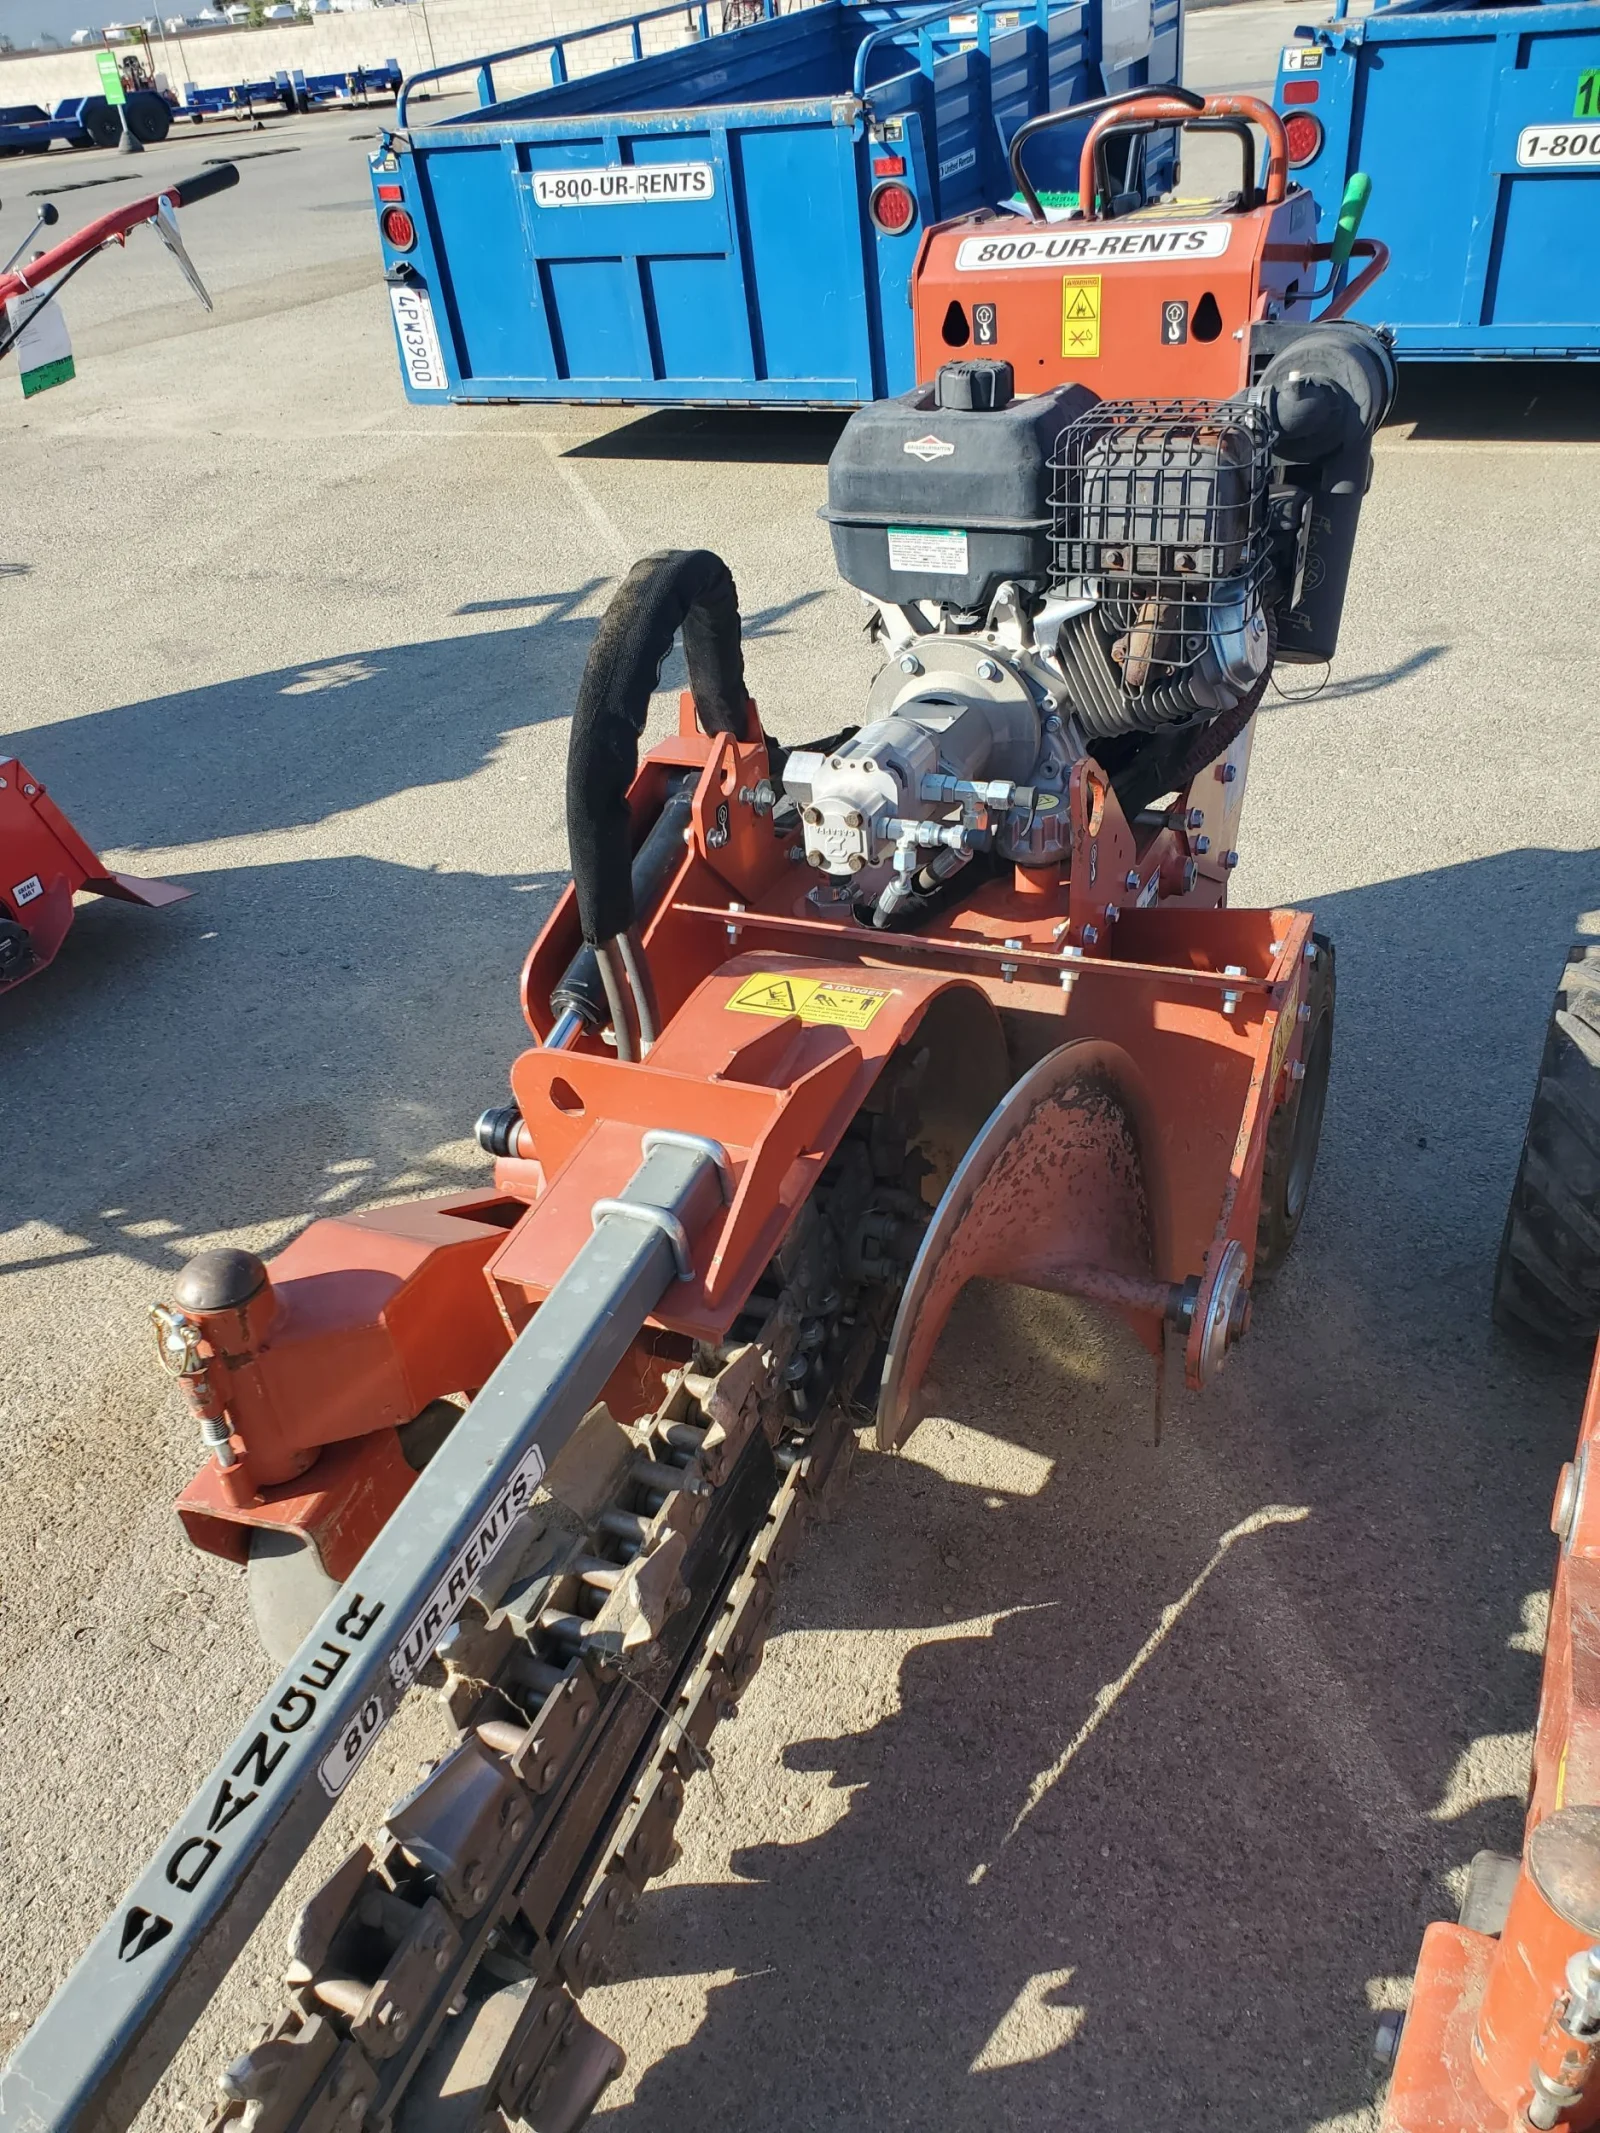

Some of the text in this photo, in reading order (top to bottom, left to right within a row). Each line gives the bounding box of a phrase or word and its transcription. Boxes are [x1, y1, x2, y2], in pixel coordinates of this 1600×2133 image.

[539, 171, 706, 199] 1-800-UR-RENTS
[977, 230, 1208, 262] 800-UR-RENTS
[398, 296, 432, 382] 4PW3900
[18, 880, 36, 895] GREASE
[834, 985, 885, 997] DANGER
[164, 1592, 385, 1894] DANGER
